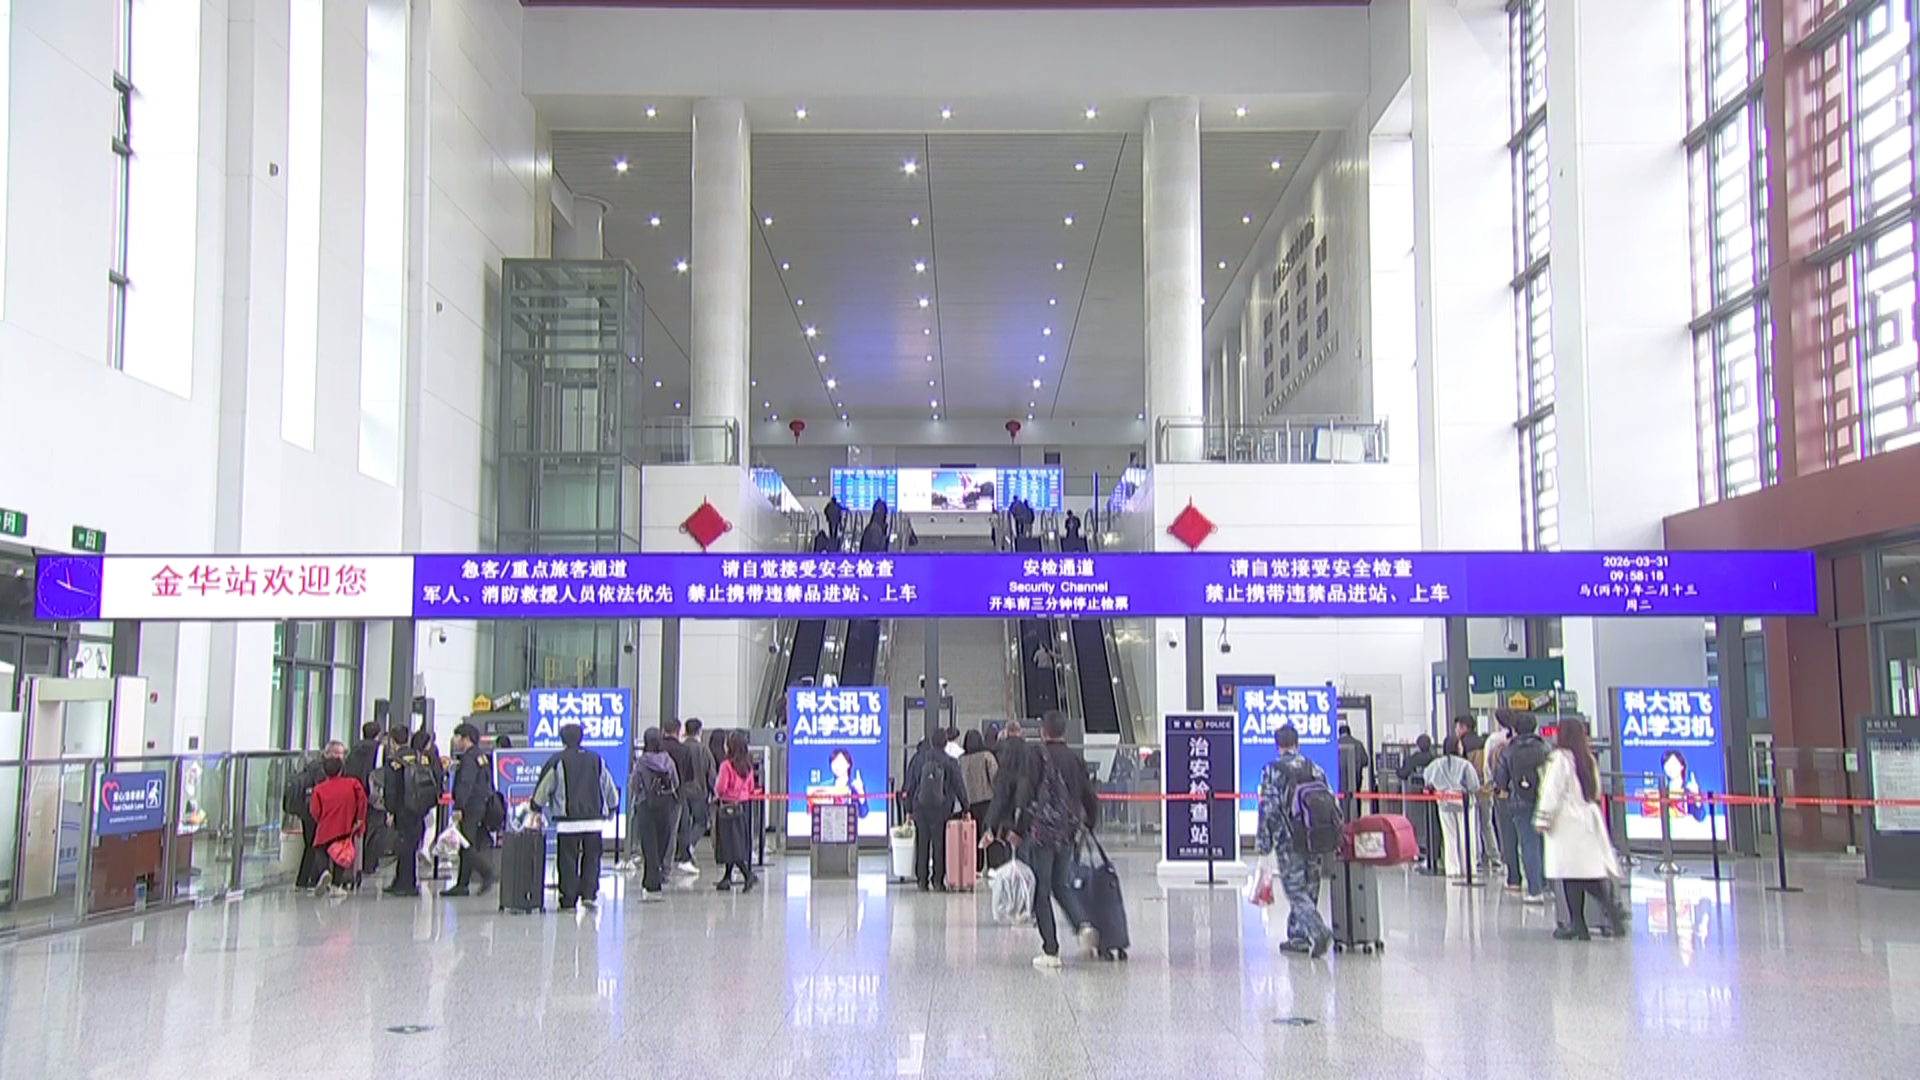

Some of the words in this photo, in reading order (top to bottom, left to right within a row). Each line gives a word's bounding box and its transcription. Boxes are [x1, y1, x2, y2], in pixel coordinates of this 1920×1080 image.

[461, 559, 628, 579] 急客/重点旅客通道
[721, 559, 895, 579] 请自觉接受安全检查
[1023, 558, 1095, 576] 安检通道
[1229, 558, 1414, 578] 请自觉接受安全检查
[1602, 556, 1669, 567] 2026-03-31
[151, 565, 367, 597] 金华站欢迎您
[1609, 570, 1665, 582] 09:58:18
[422, 584, 674, 605] 军人、消防救援人员依法优先
[687, 583, 918, 603] 禁止携带违禁品进站、上车
[1009, 581, 1056, 594] Security
[1060, 581, 1109, 593] Channel
[1205, 583, 1450, 603] 禁止携带违禁品进站、上车
[989, 596, 1129, 611] 开车前三分钟停止检票
[1625, 599, 1652, 612] 周二
[1493, 674, 1536, 688] 出口
[537, 692, 624, 715] 科大讯飞
[796, 690, 882, 713] 科大讯飞
[1244, 689, 1331, 712] 科大讯飞
[1623, 690, 1713, 714] 科大讯飞
[793, 714, 882, 737] AI学习机
[1205, 720, 1231, 729] POLICE
[1623, 714, 1715, 738] AI学习机
